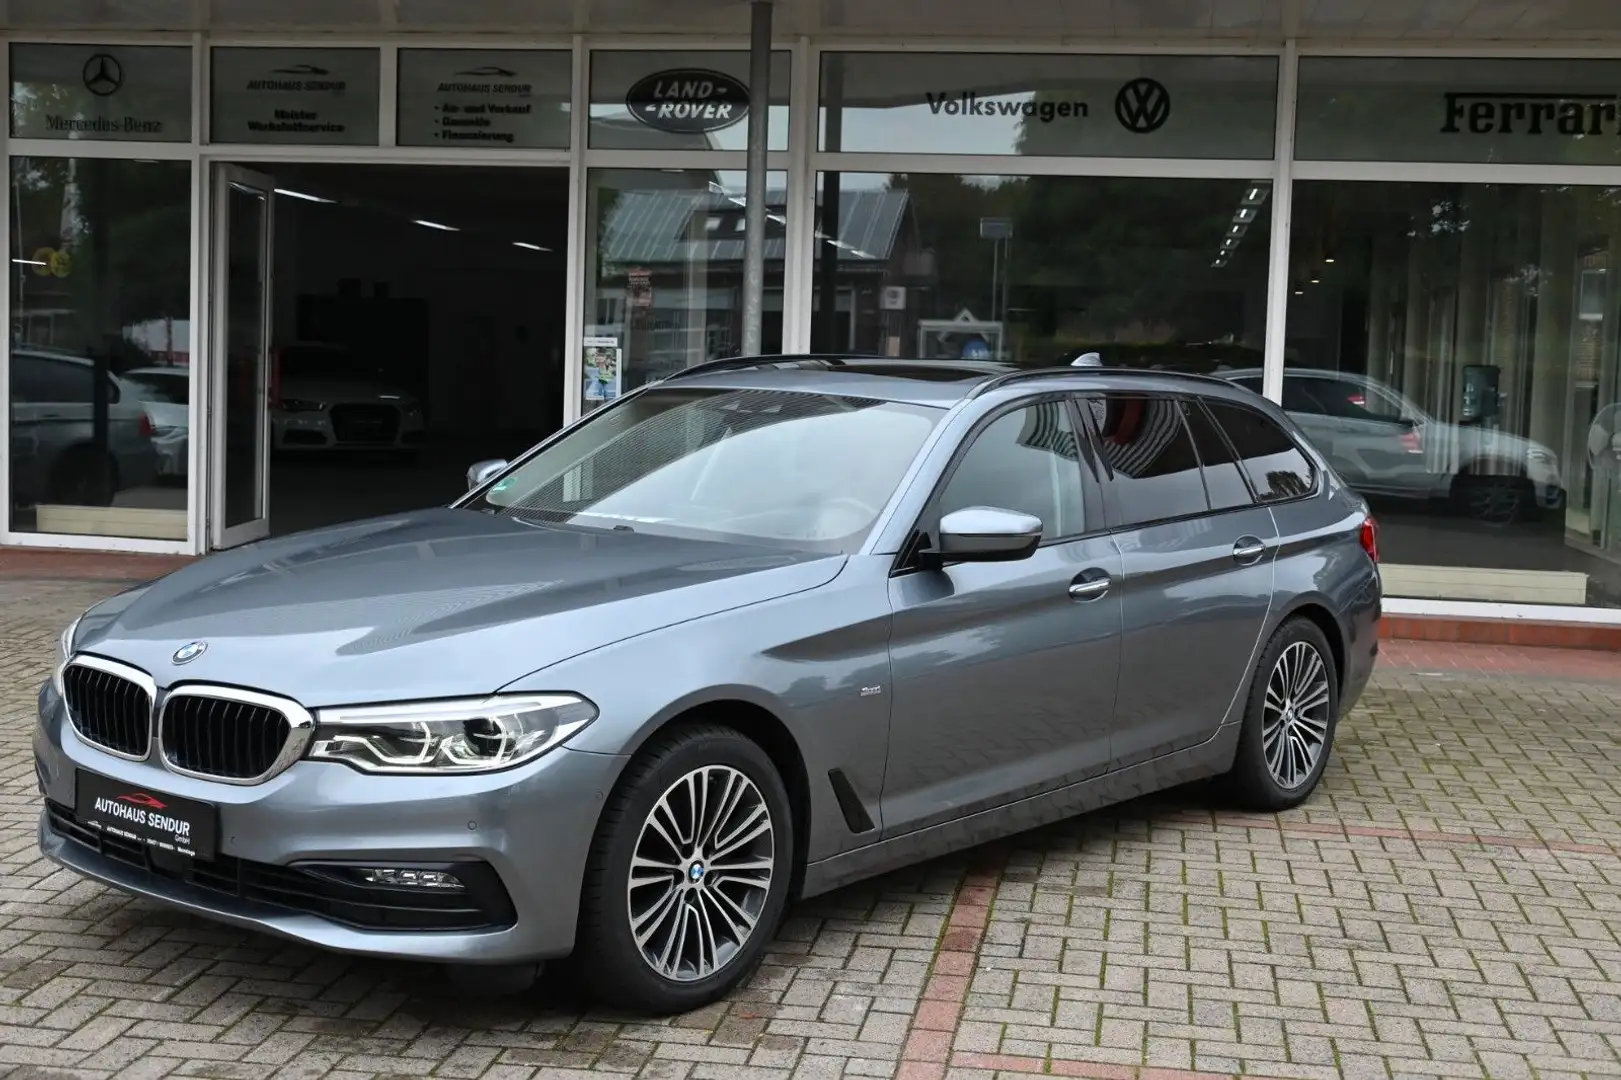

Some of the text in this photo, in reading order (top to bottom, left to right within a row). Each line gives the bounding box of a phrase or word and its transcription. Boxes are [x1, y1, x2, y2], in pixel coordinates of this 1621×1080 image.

[437, 82, 490, 93] AUTOHAUS
[654, 81, 714, 98] LAND
[488, 103, 532, 114] Verkauf
[658, 101, 732, 119] ROVER
[926, 92, 1088, 123] Volkswagen
[1440, 92, 1621, 135] Ferrar
[45, 114, 163, 133] Mercedes-Benz
[94, 797, 190, 836] AUTOHAUS SENDUR
[174, 834, 190, 845] GmbH
